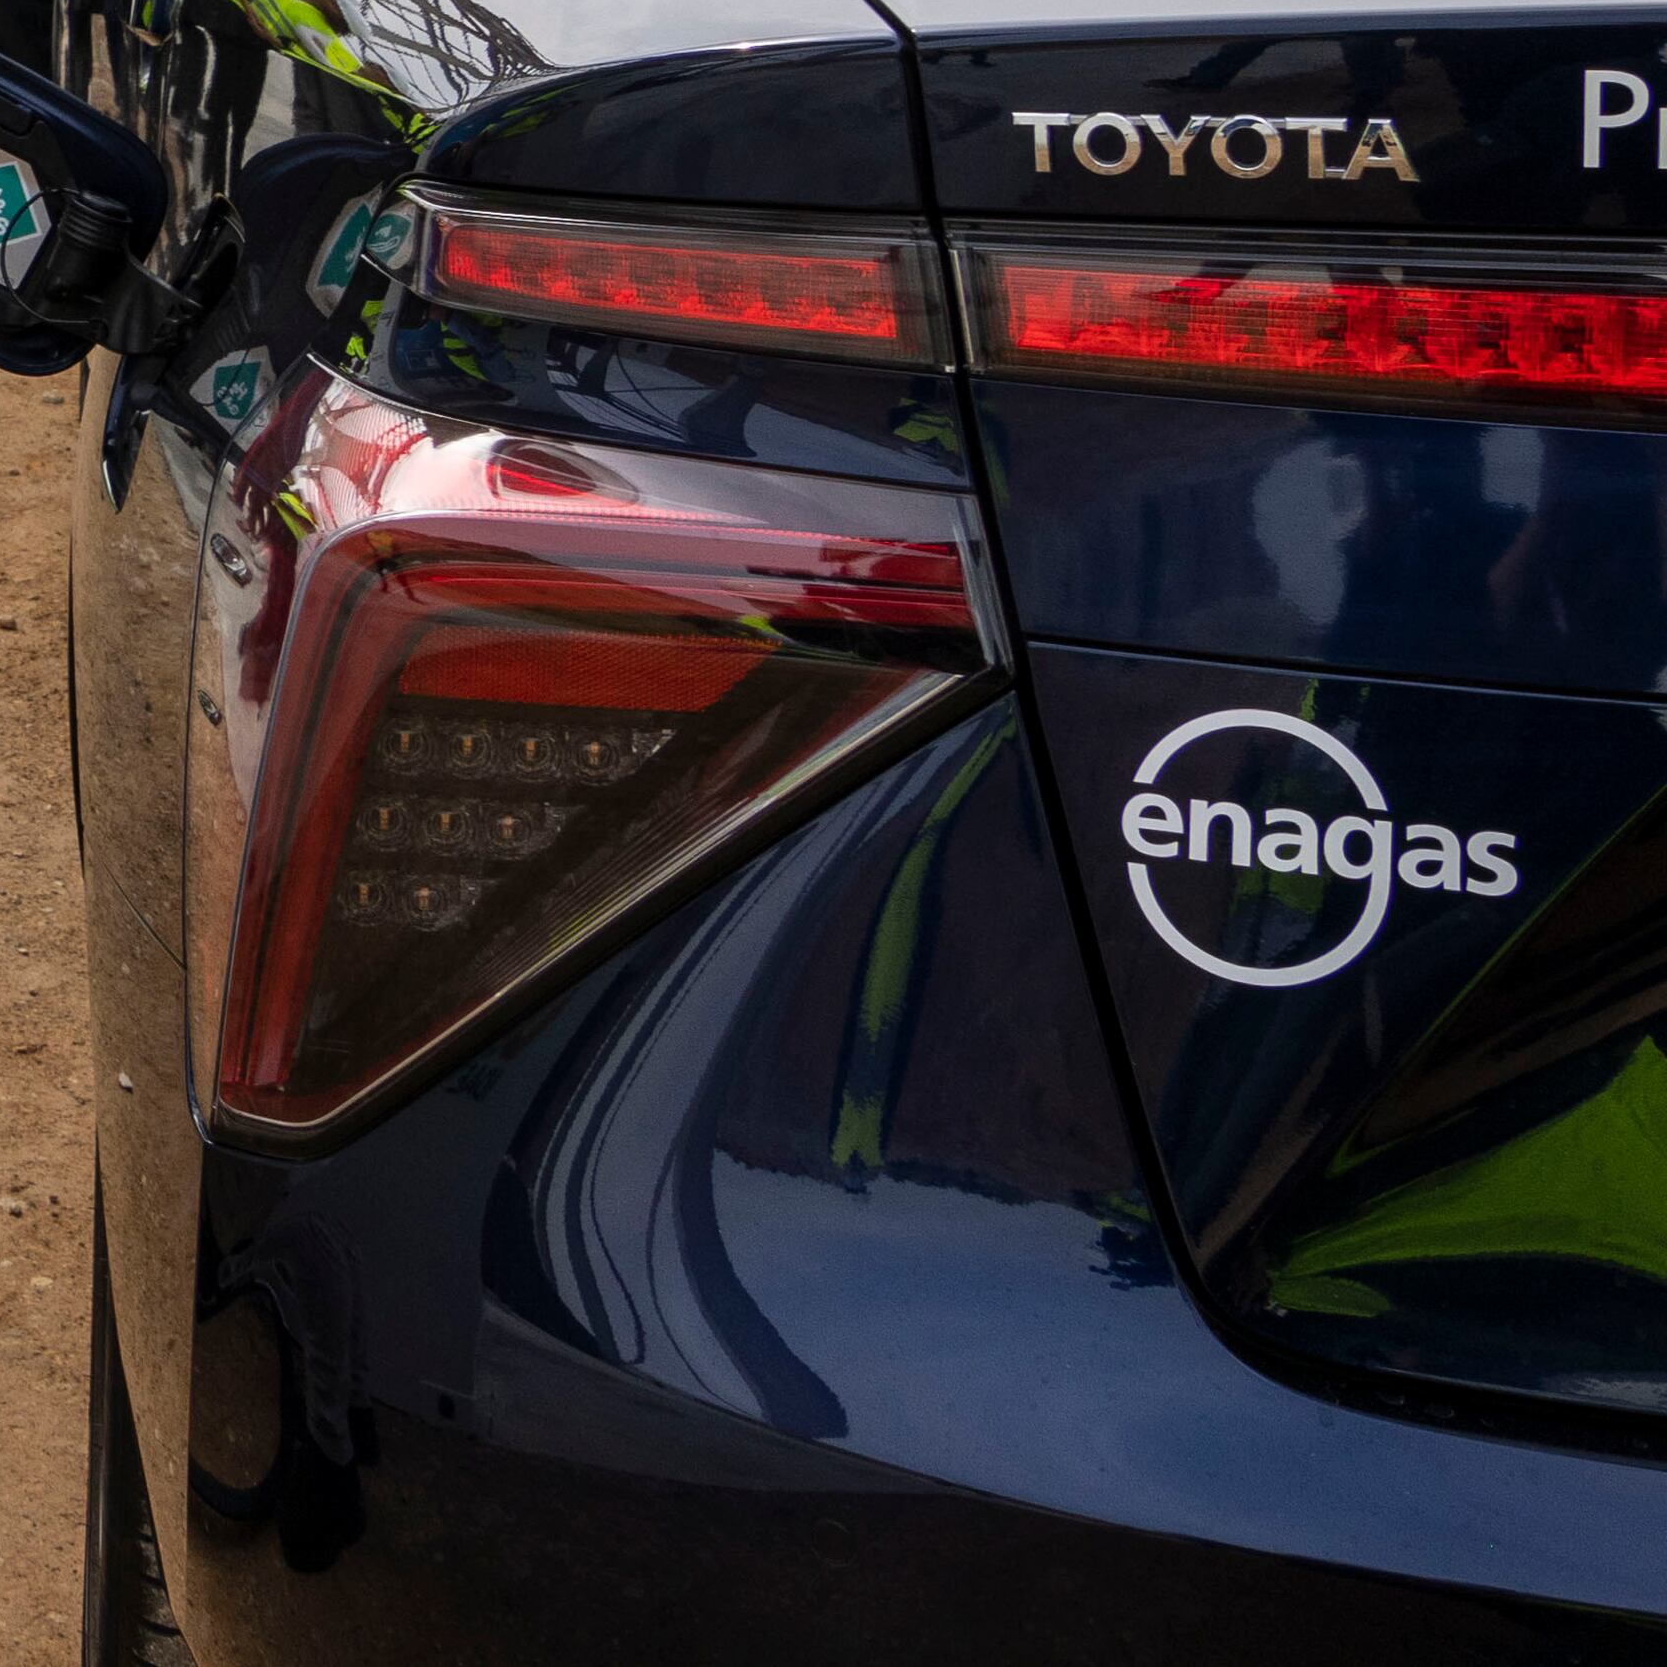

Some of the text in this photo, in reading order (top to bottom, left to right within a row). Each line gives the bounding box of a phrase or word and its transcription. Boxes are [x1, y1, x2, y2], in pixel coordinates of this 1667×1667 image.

[1012, 111, 1421, 183] TOYOTA
[1582, 69, 1667, 170] P
[1121, 792, 1519, 897] enagas
